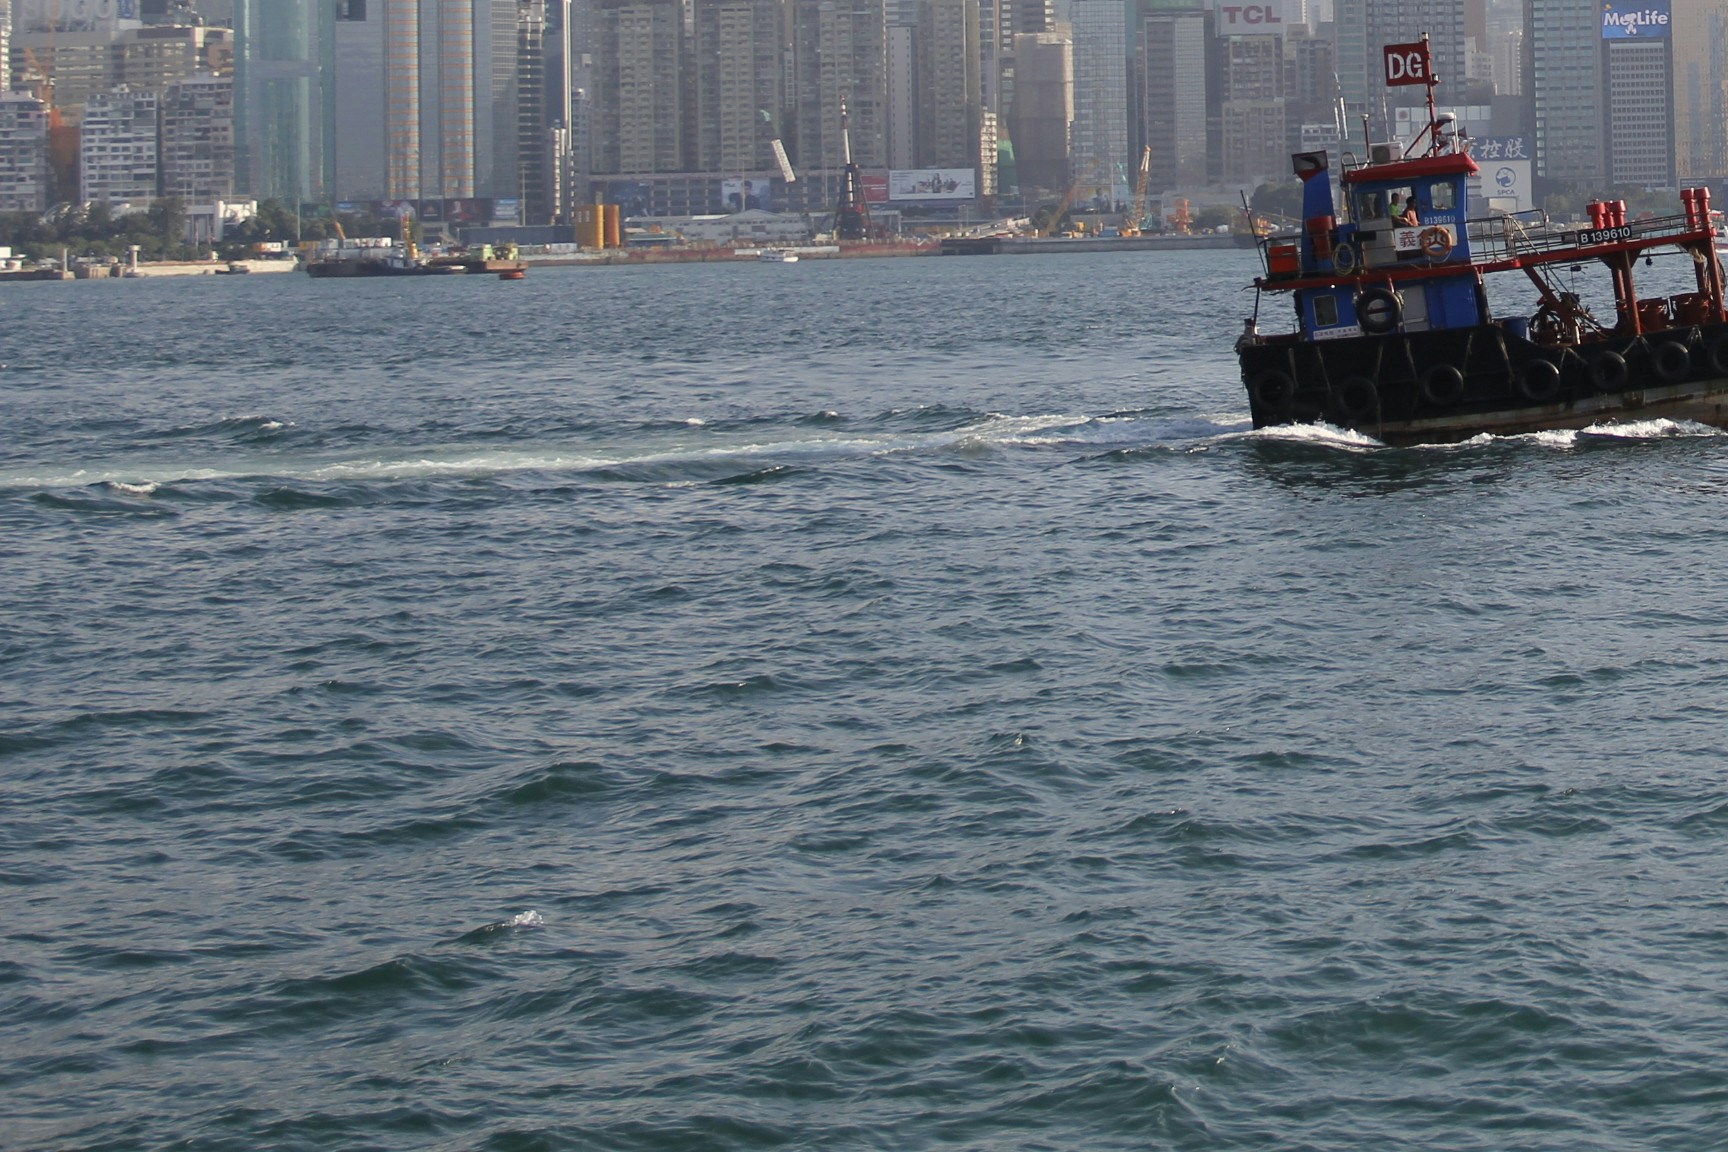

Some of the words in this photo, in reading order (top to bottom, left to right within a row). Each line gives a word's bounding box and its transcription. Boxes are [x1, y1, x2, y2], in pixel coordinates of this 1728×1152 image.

[1222, 5, 1281, 24] TCL
[1604, 9, 1668, 26] MeLife
[1387, 52, 1423, 80] DG
[1424, 215, 1456, 225] B139610
